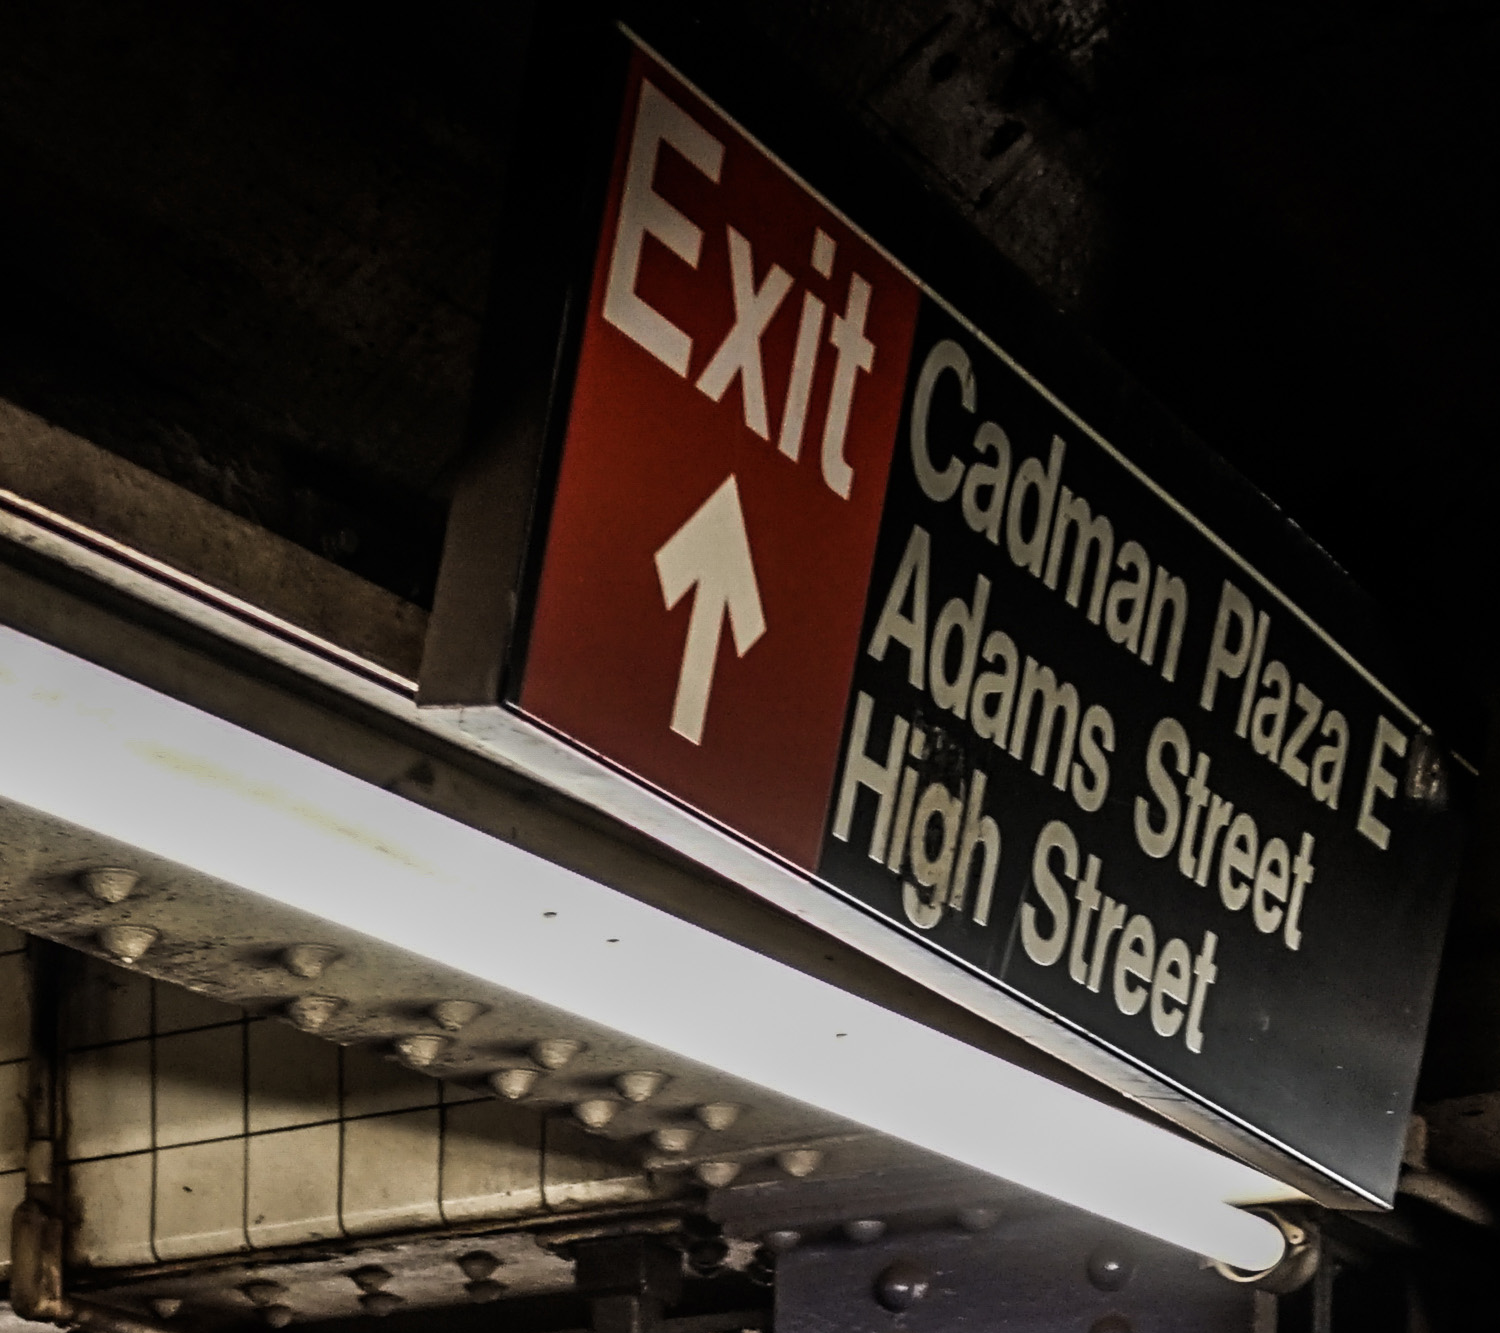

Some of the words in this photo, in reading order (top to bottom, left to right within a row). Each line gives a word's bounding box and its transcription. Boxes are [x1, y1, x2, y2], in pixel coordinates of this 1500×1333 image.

[601, 78, 877, 503] Exit
[867, 525, 1117, 813] Adams
[1133, 719, 1317, 952] Street
[908, 337, 1190, 684] Cadman
[1199, 581, 1352, 813] Plaza
[1357, 714, 1410, 851] E
[834, 694, 1001, 929] High
[1021, 820, 1219, 1055] Street
